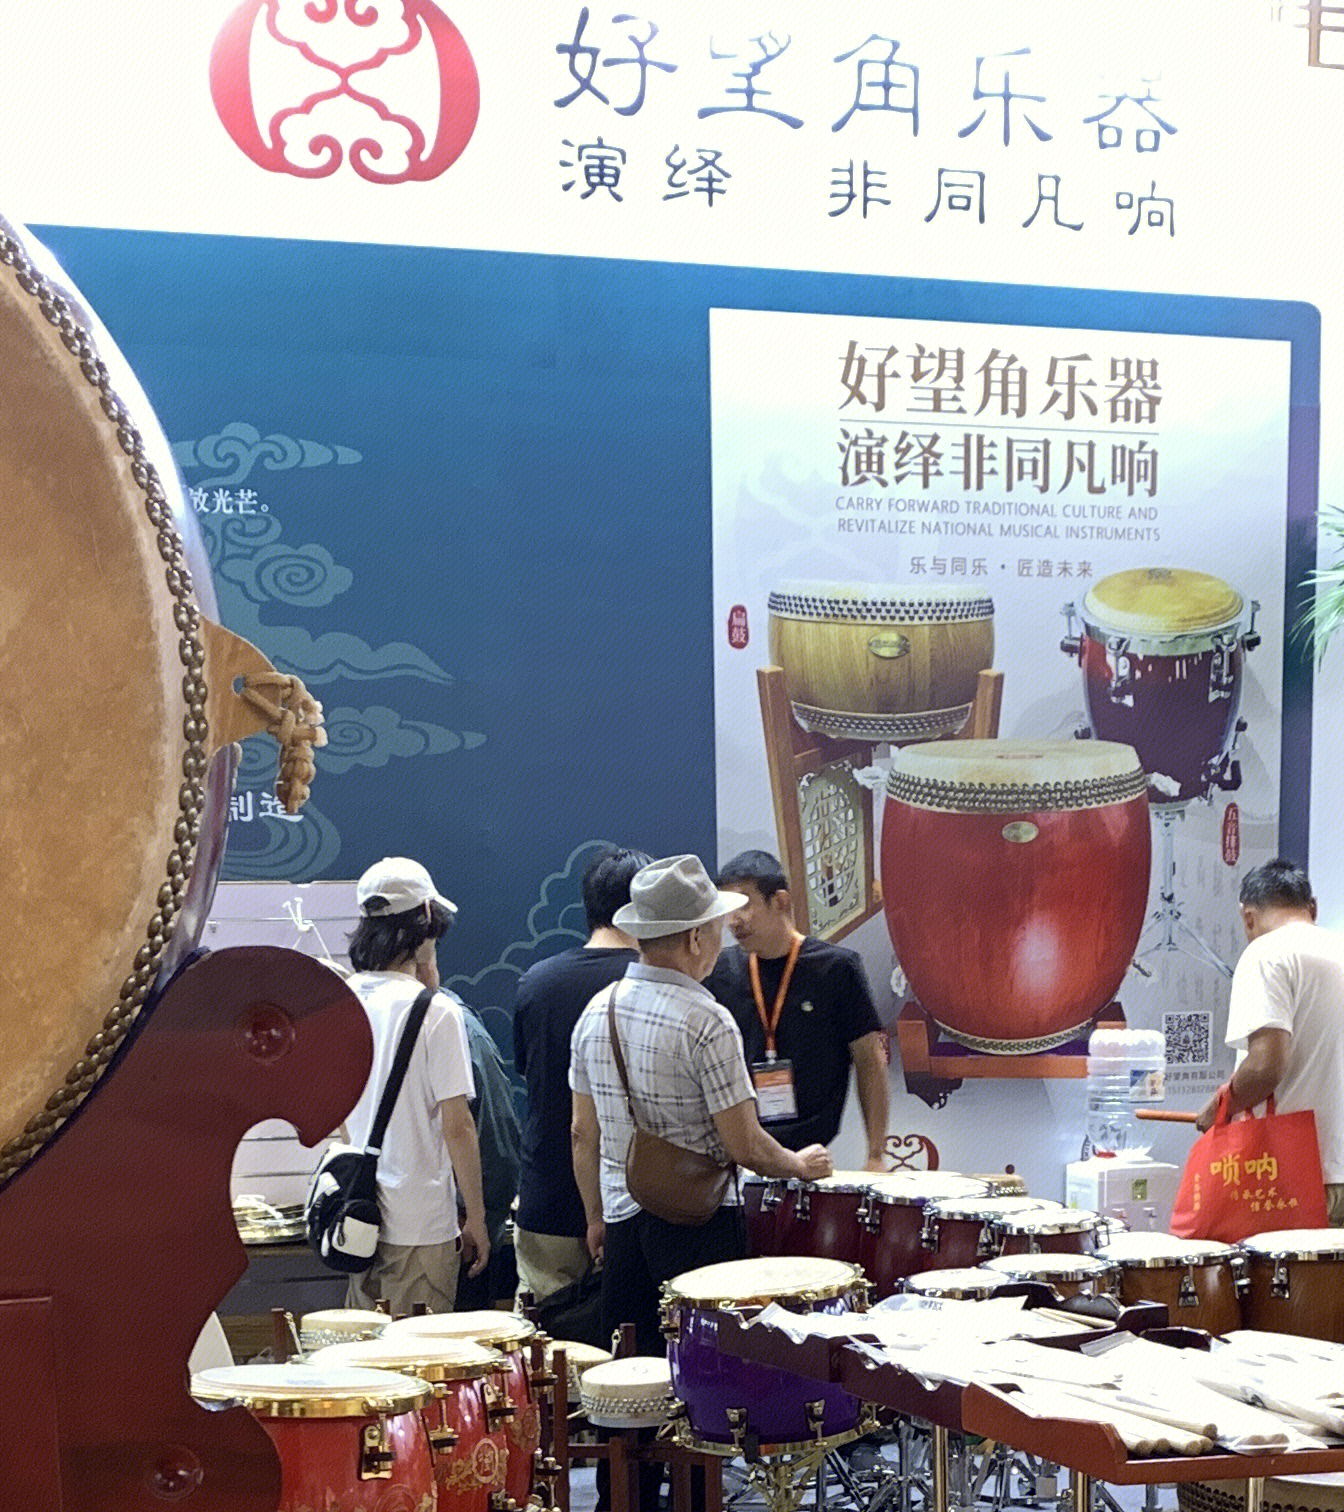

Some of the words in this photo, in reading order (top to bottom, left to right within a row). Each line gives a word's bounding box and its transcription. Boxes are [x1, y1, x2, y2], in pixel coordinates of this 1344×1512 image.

[554, 6, 1179, 154] 好望角乐器
[559, 137, 732, 208] 演绎
[828, 160, 1176, 237] 非同凡响
[837, 340, 1164, 424] 好望角乐器
[836, 427, 1160, 498] 演绎非同凡响
[835, 496, 883, 511] CARRY
[888, 498, 960, 514] FORWARD
[965, 500, 1058, 518] TRADITIONAL
[1062, 504, 1123, 519] CULTURE
[1128, 506, 1159, 521] AND
[837, 518, 916, 534] REVITALIZE
[921, 521, 994, 537] NATIONAL
[999, 524, 1060, 539] MUSICAL
[1065, 526, 1161, 541] INSTRUMENTS
[1209, 1152, 1279, 1187] 唢呐
